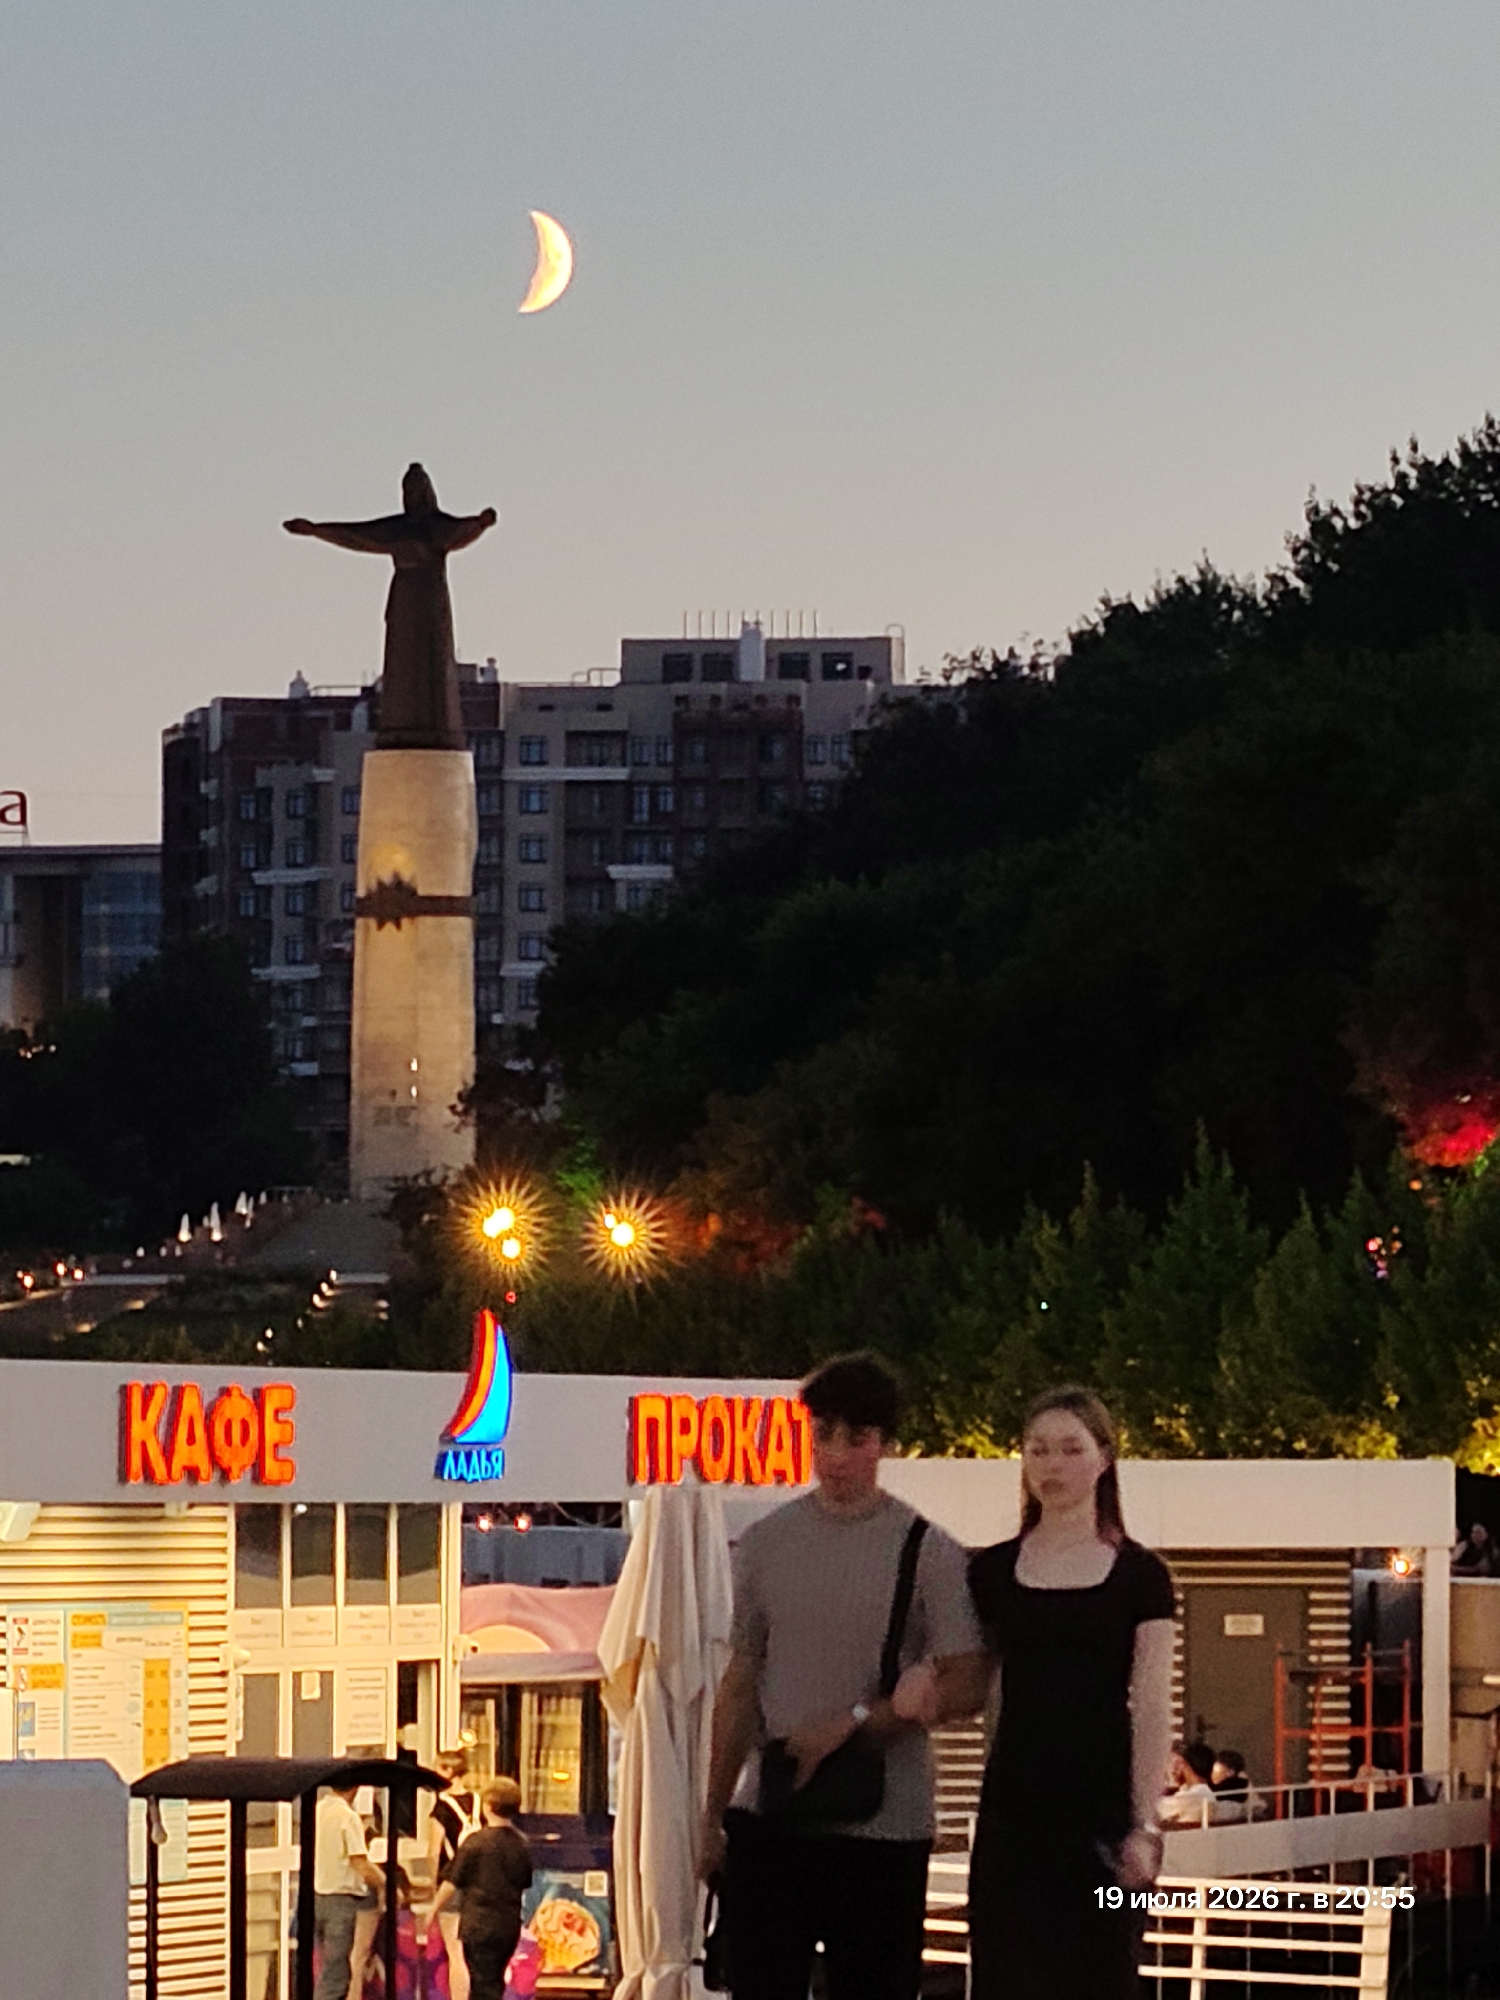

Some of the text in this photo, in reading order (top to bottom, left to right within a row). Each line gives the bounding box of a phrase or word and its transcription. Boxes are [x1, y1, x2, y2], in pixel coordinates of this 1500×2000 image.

[124, 1381, 296, 1485] КАФЕ
[442, 1447, 503, 1483] ЛАДЬЯ
[633, 1392, 813, 1487] ПРОКАТ
